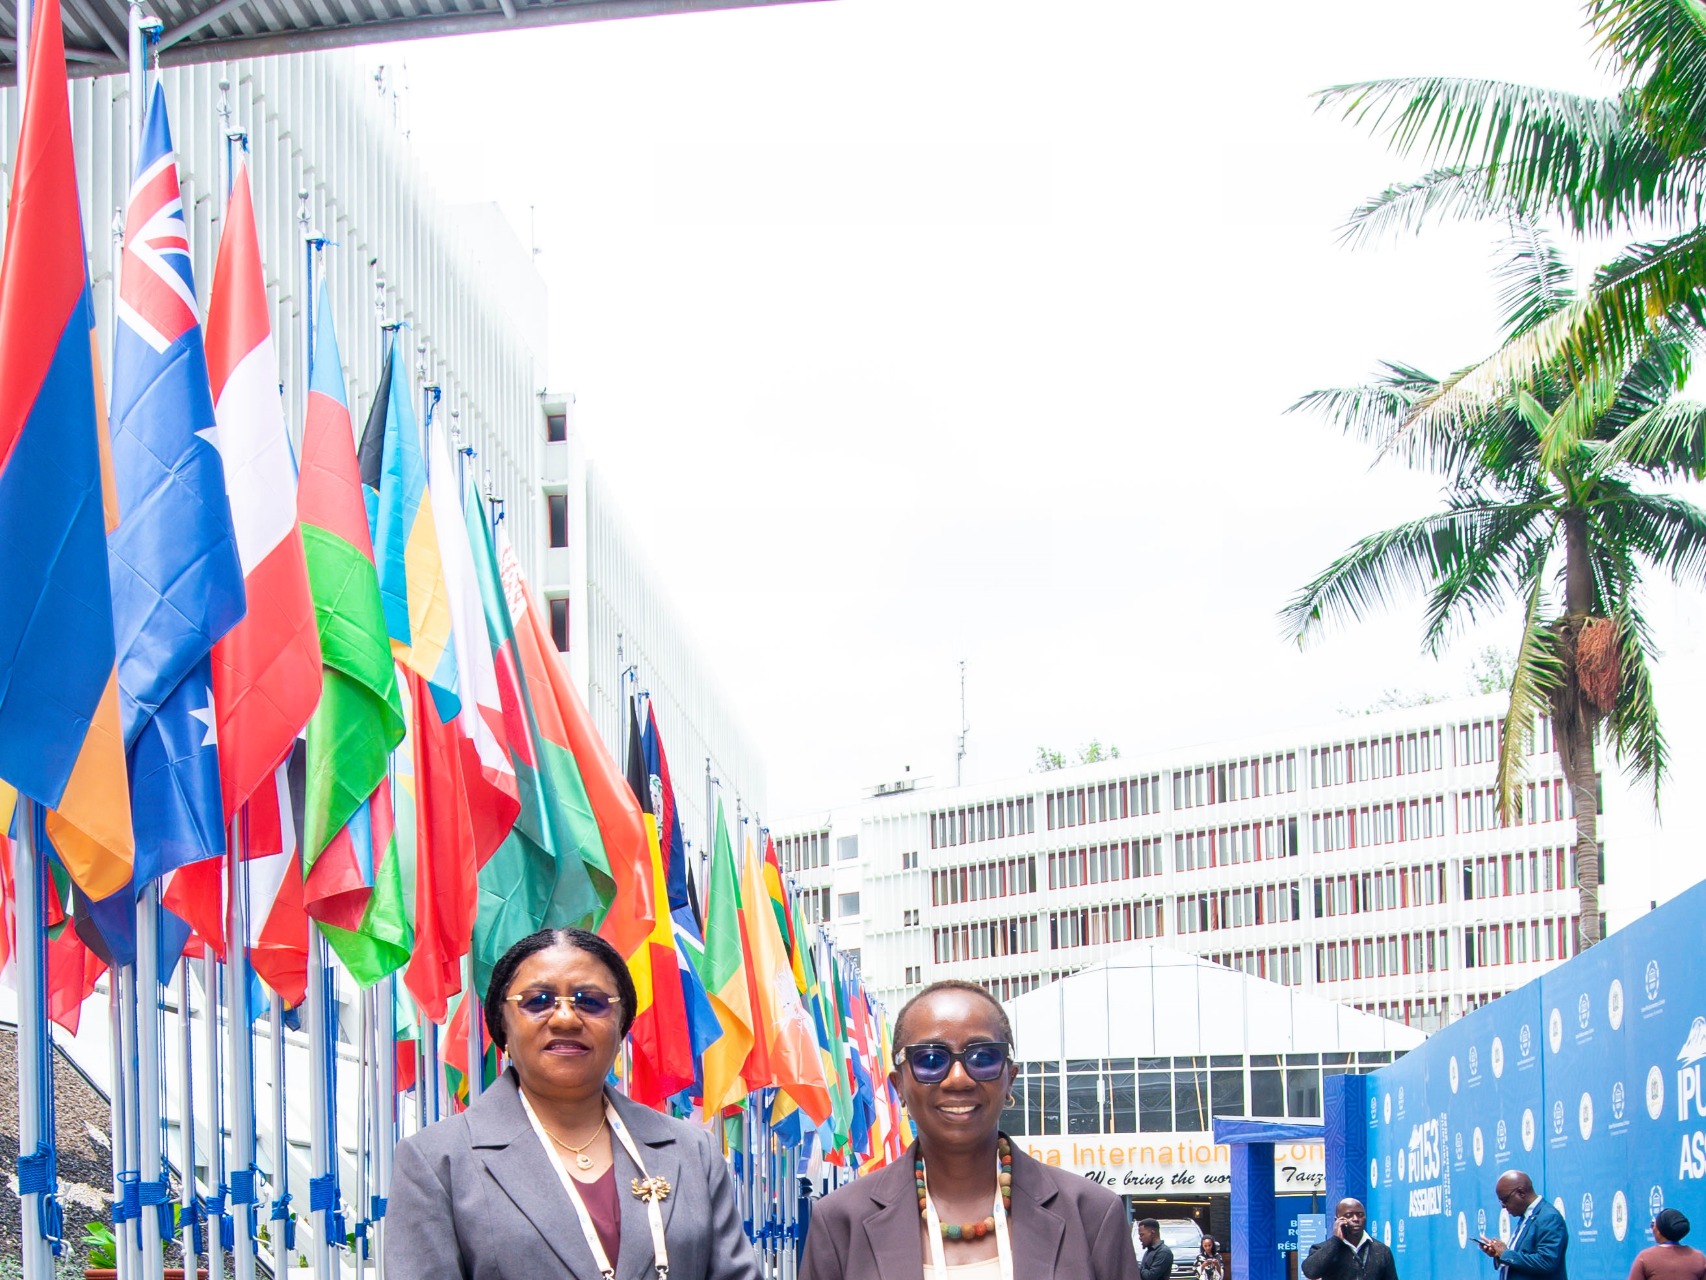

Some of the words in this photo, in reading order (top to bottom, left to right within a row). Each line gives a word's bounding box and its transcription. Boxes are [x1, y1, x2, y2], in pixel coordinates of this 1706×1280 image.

[1028, 1144, 1061, 1166] ha
[1073, 1139, 1228, 1166] Internation
[1679, 1131, 1706, 1180] AS
[1085, 1171, 1116, 1185] We
[1123, 1170, 1165, 1190] bring
[1171, 1169, 1195, 1185] the
[1203, 1174, 1231, 1184] wor
[1281, 1166, 1326, 1187] Tanz
[1408, 1184, 1442, 1218] ASSEMBLY
